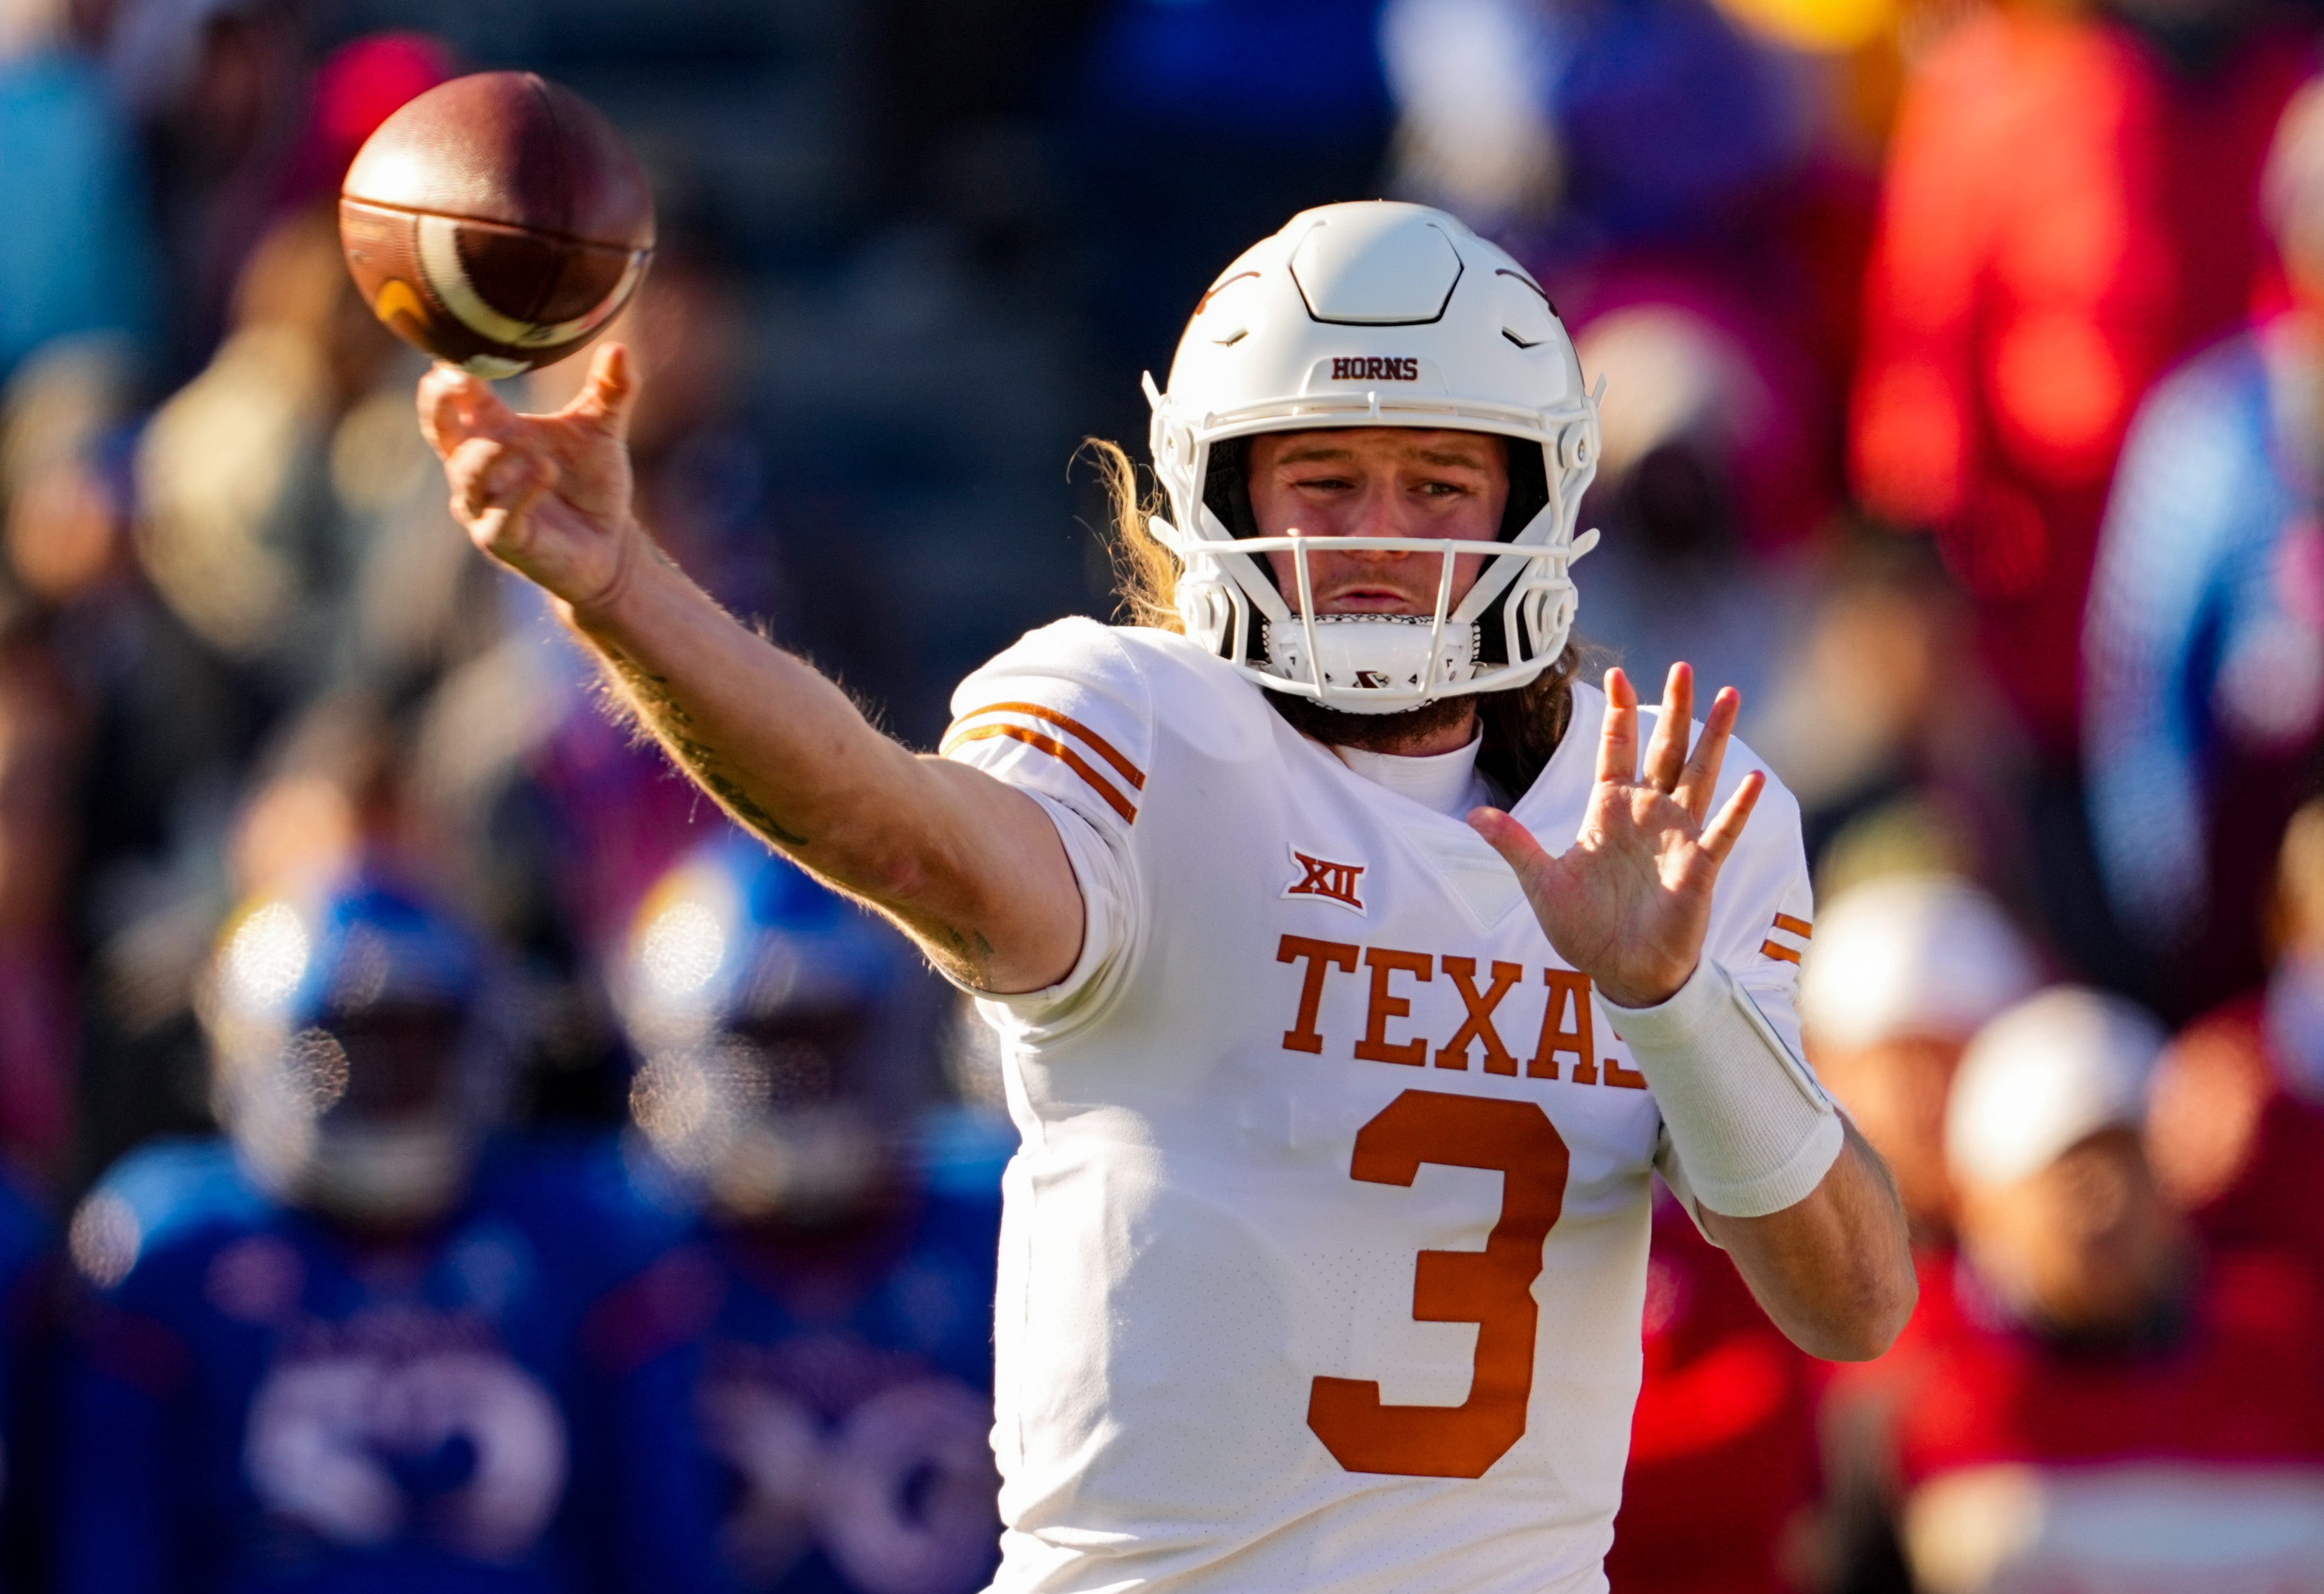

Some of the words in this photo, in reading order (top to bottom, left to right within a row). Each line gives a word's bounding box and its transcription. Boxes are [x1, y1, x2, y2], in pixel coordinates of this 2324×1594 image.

[1332, 357, 1418, 380] HORNS
[1288, 850, 1365, 910] XII
[1307, 1088, 1569, 1479] 3
